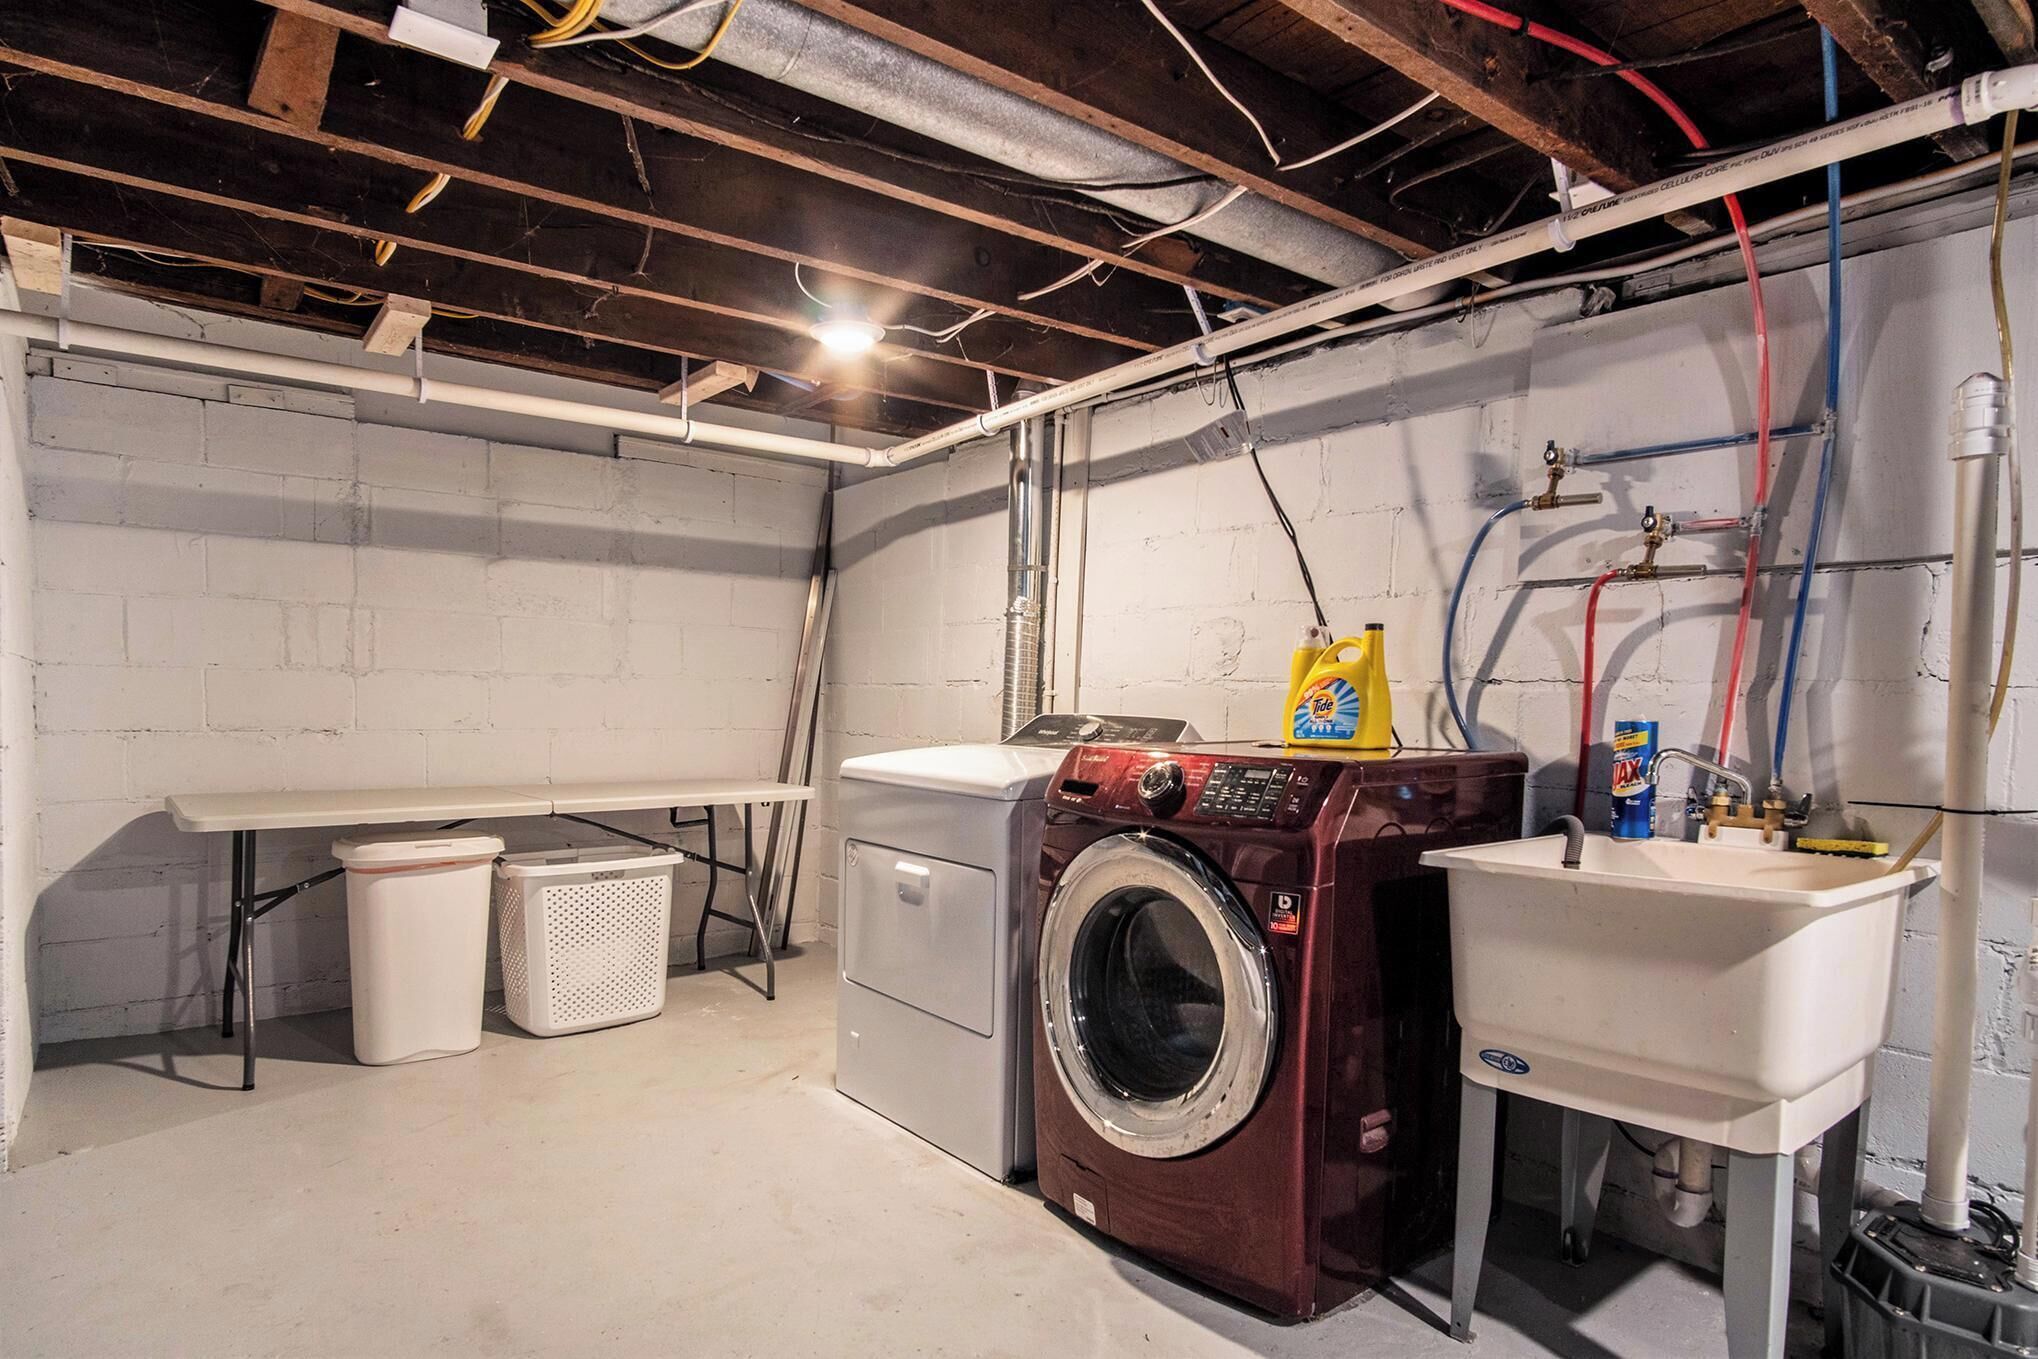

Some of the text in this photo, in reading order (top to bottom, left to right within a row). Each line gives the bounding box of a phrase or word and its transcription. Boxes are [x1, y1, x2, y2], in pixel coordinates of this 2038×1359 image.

[1660, 171, 1702, 191] CELLULAR
[1704, 162, 1728, 177] CORE
[1760, 146, 1779, 159] DWV
[1380, 274, 1391, 283] FOR
[1392, 267, 1412, 279] DRAIN
[1413, 259, 1433, 272] WASTE
[1434, 255, 1446, 265] AND
[1448, 249, 1464, 261] VENT
[1465, 243, 1483, 255] ONLY
[1313, 697, 1334, 715] Tide
[1612, 757, 1643, 792] JAX
